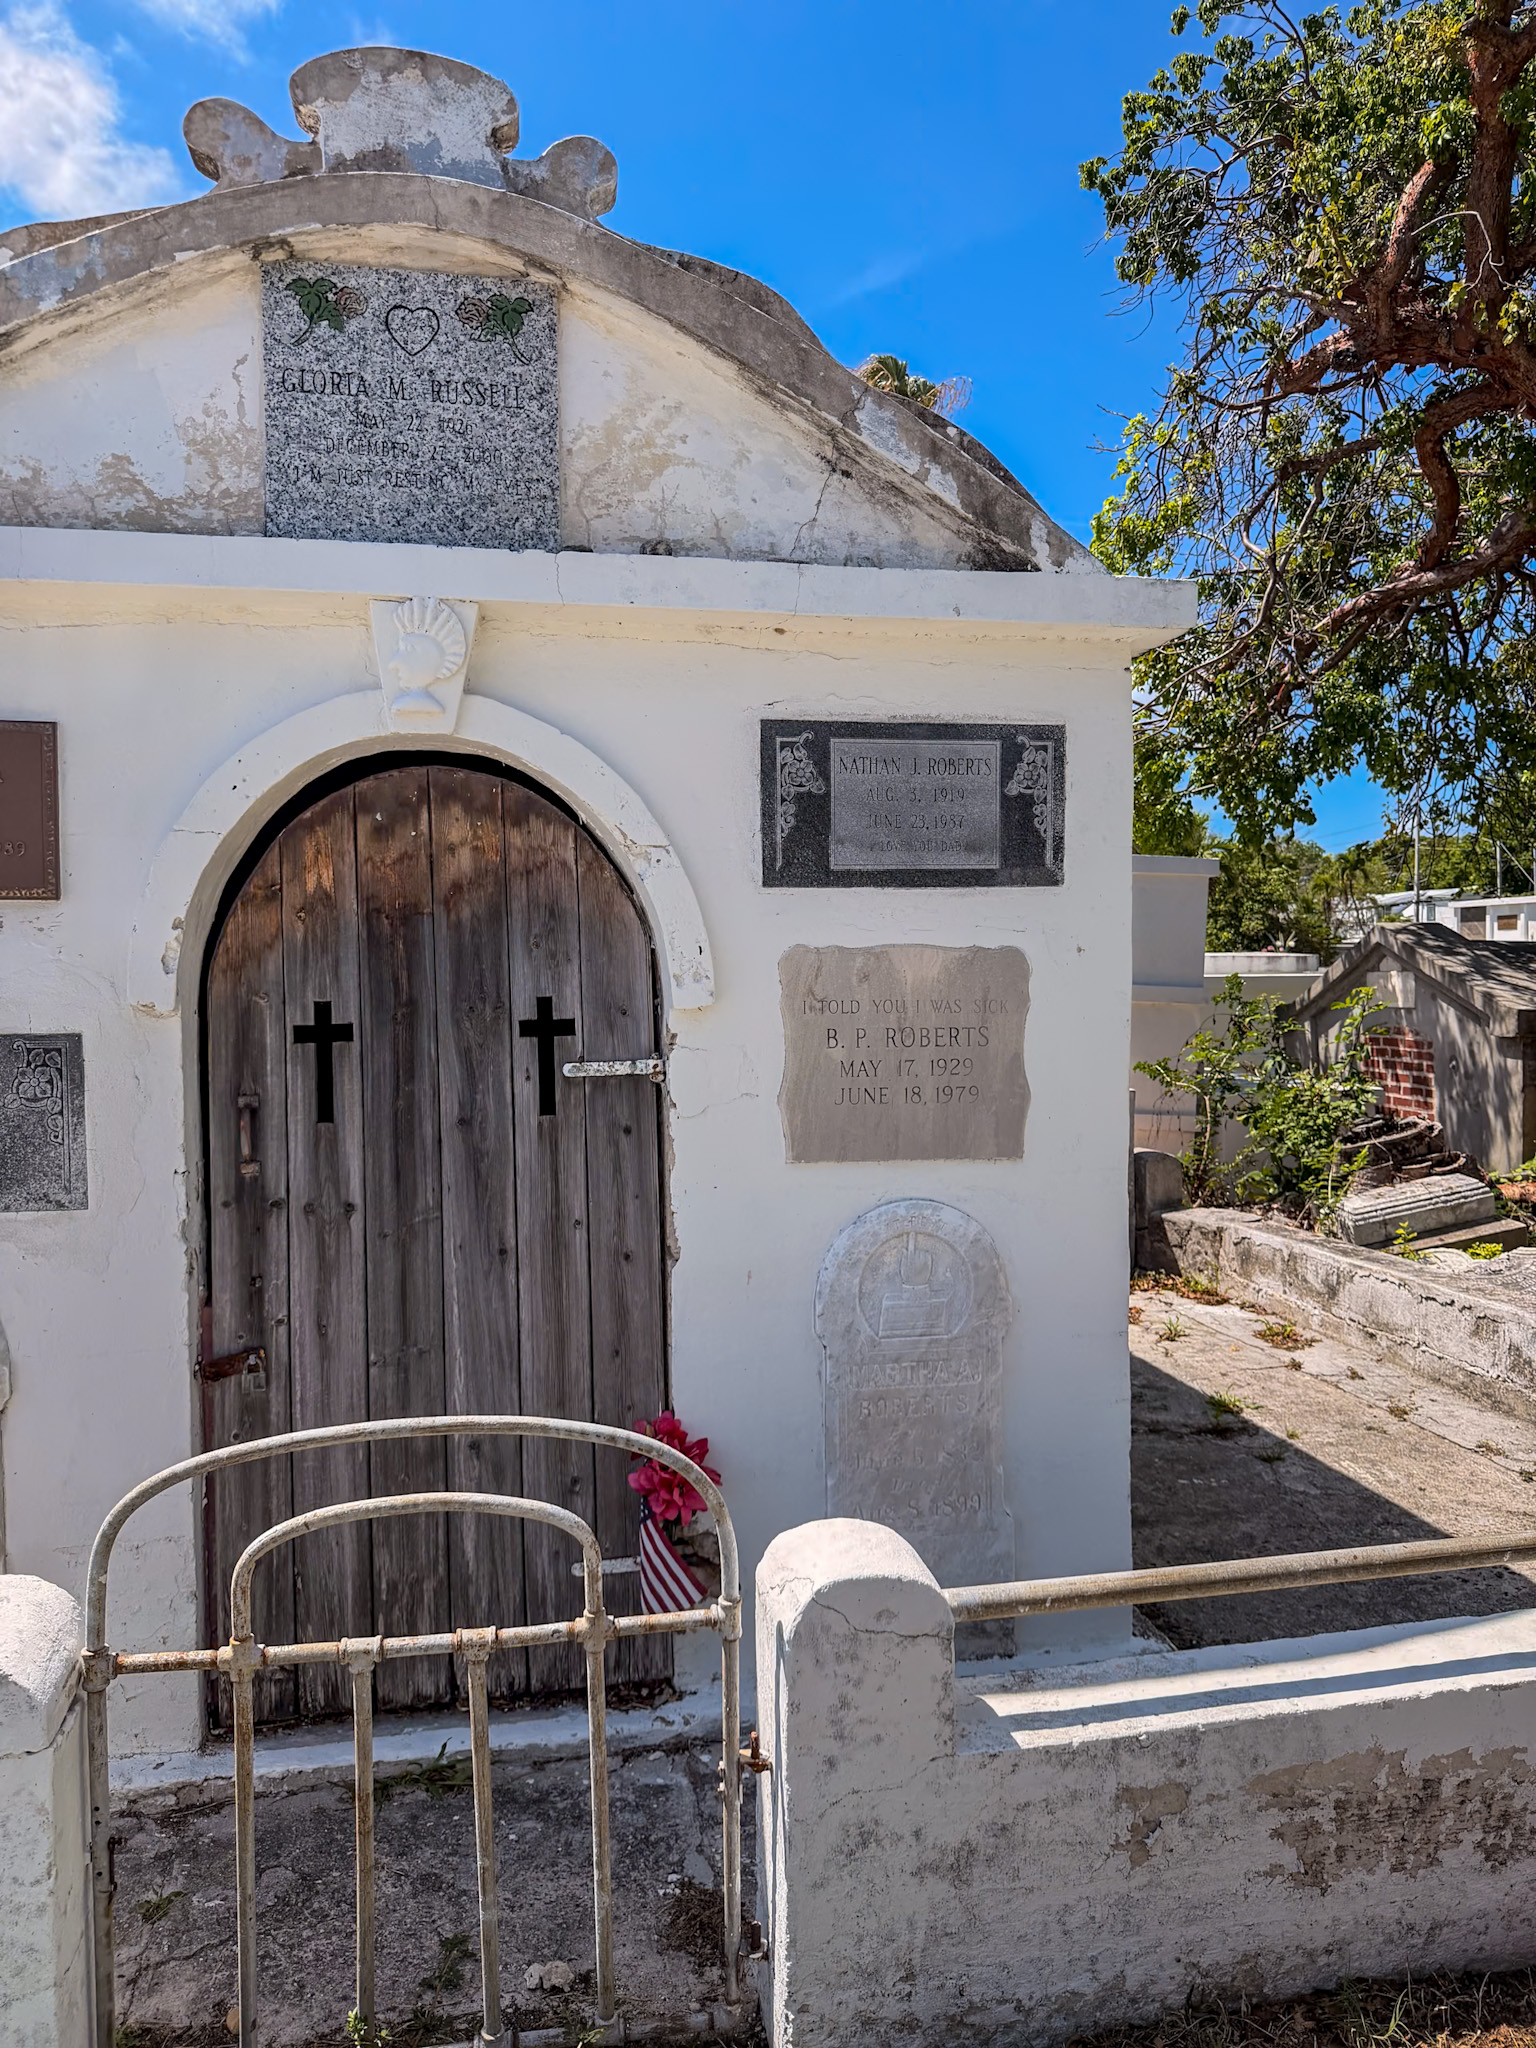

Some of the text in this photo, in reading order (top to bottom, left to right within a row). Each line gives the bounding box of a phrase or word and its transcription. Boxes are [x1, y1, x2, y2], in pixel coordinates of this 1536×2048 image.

[282, 368, 370, 397] GLORIA
[431, 379, 525, 410] RUSSELL
[355, 411, 388, 430] MAY
[323, 436, 410, 458] DECEMBER
[336, 468, 373, 486] JUST
[839, 756, 992, 776] NATHAN J. ROBERTS
[866, 787, 899, 802] AUG.
[934, 787, 965, 802] 1919
[866, 814, 902, 829] JUNE
[0, 841, 25, 856] 89
[803, 999, 1009, 1015] I TOLD YOU I WAS SICK
[826, 1026, 990, 1049] B. P. ROBERTS
[839, 1058, 974, 1079] MAY 17, 1929
[835, 1085, 981, 1107] JUNE 18, 1979
[848, 1360, 949, 1388] MARTHA
[859, 1394, 969, 1420] ROBERTS
